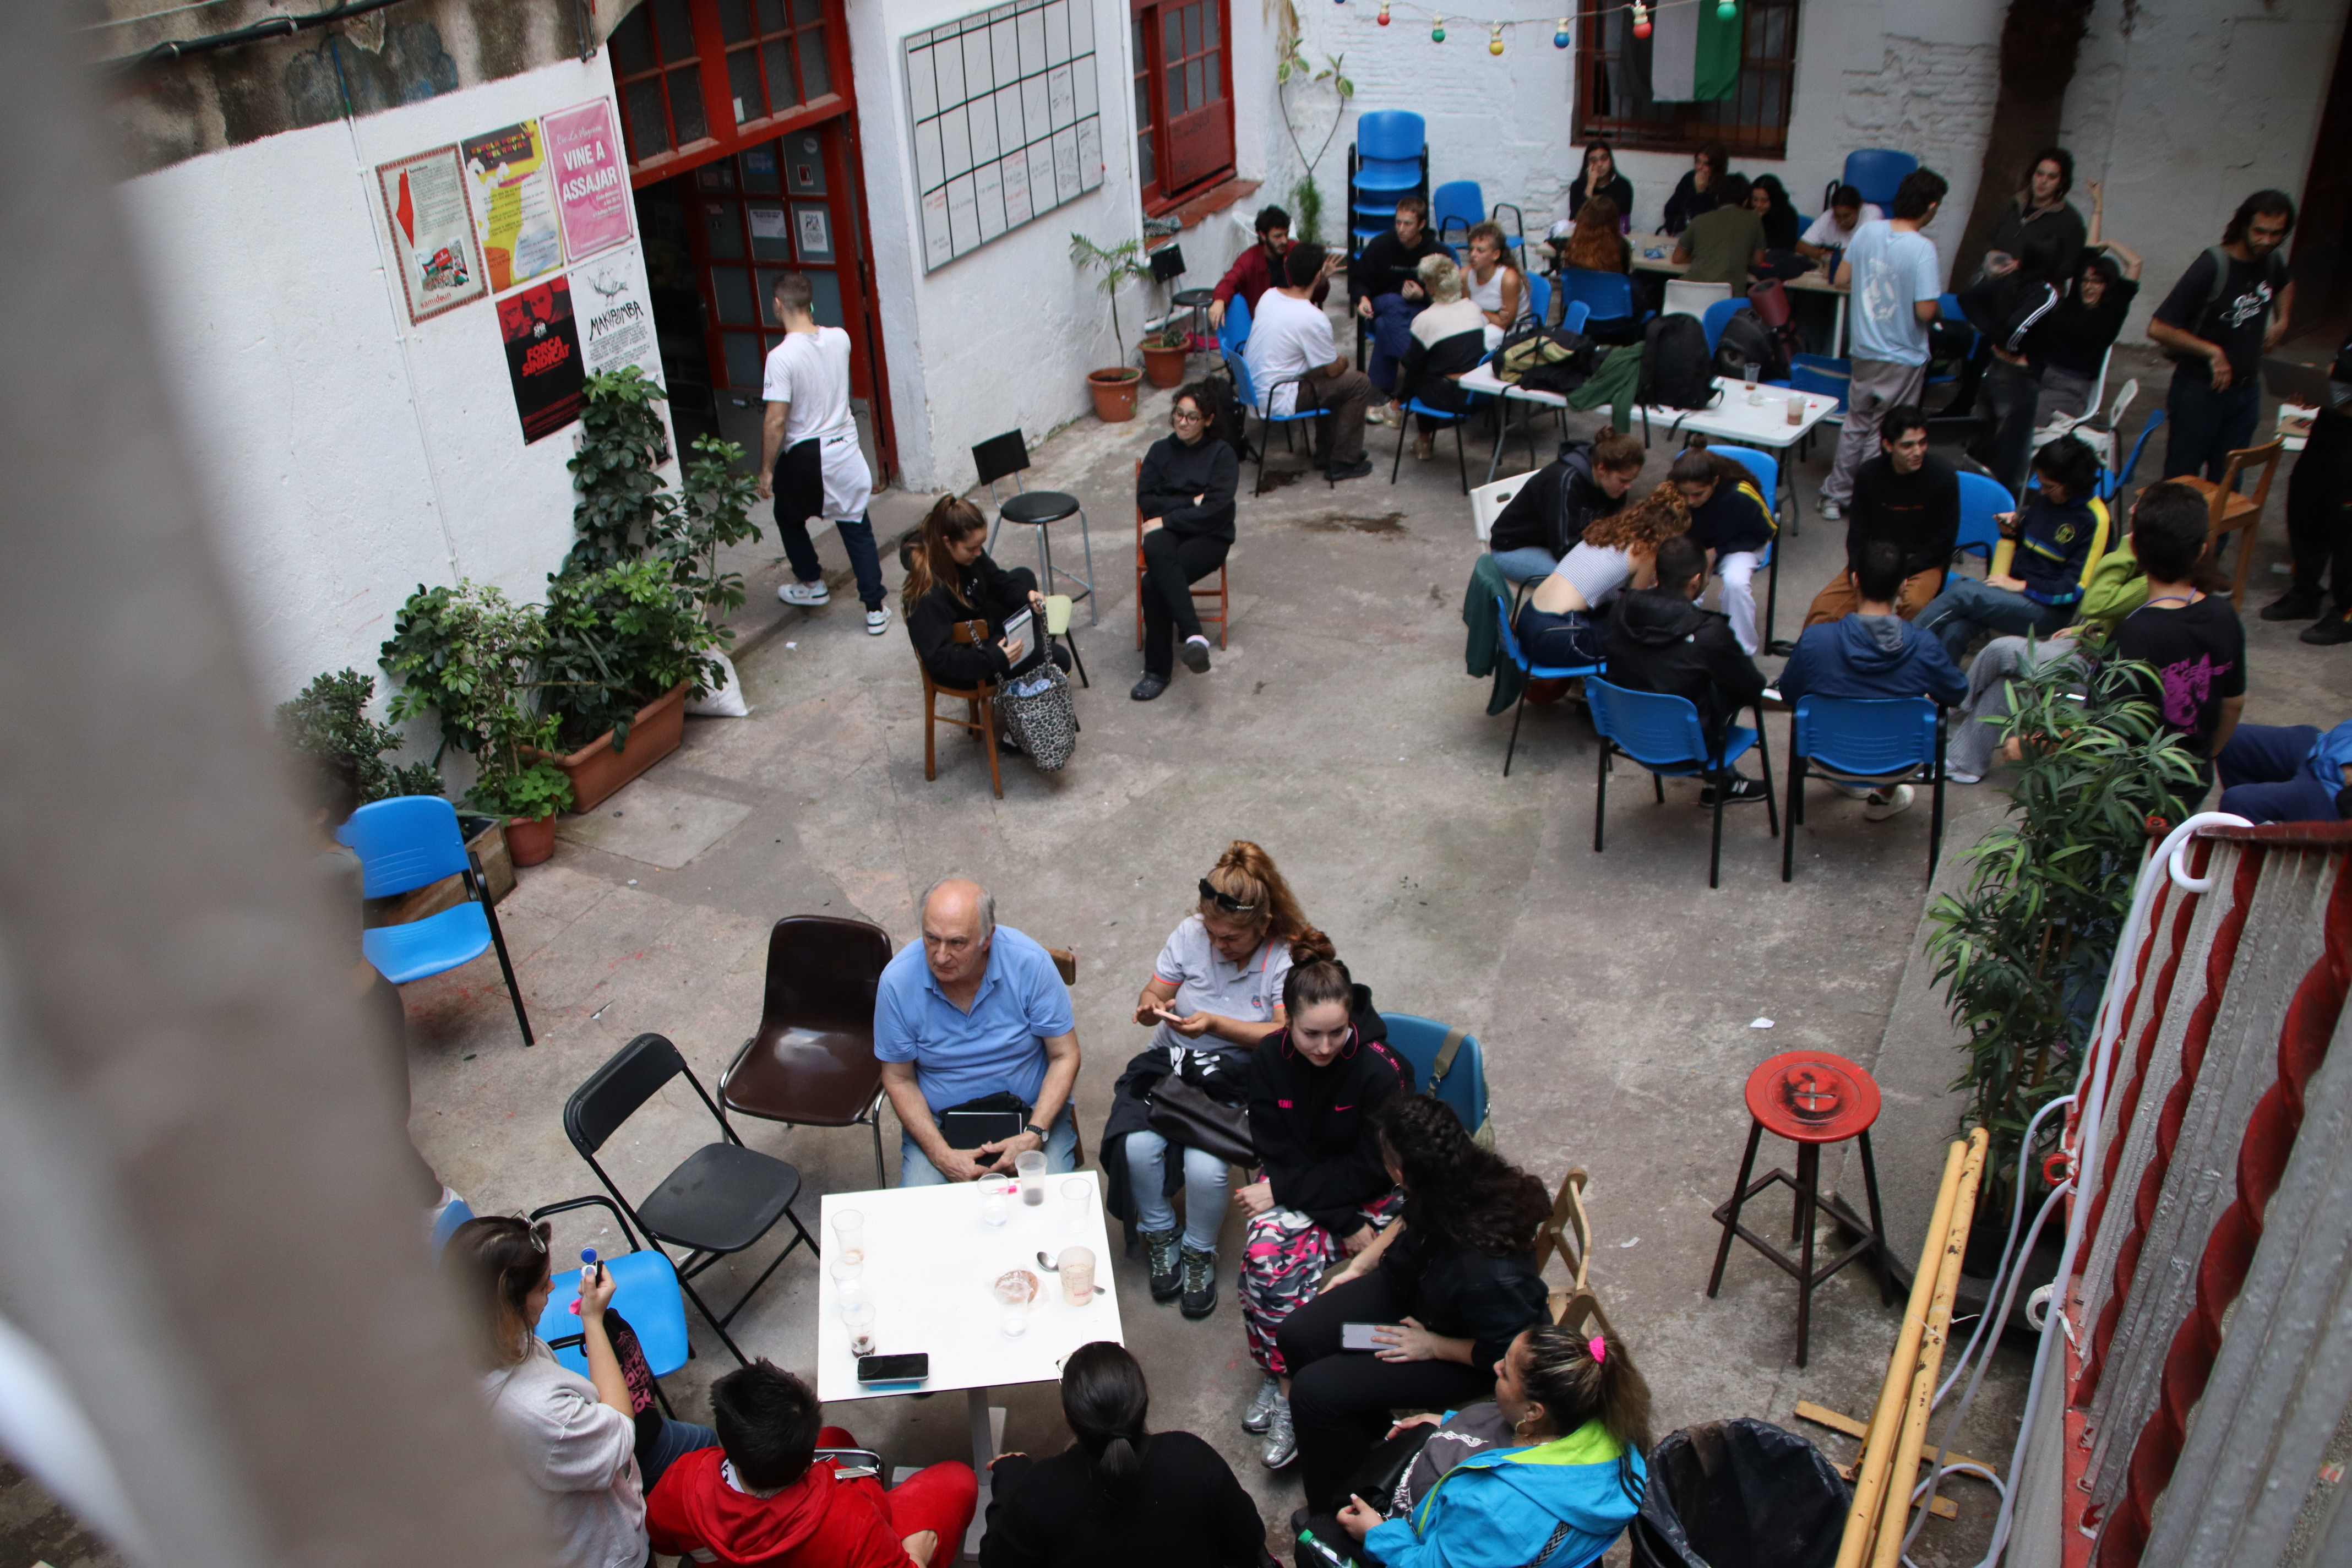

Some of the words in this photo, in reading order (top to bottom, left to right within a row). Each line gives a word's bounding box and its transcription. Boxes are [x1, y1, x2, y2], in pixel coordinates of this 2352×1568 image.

[471, 140, 500, 155] ESCOLA
[486, 149, 501, 159] DEL
[502, 141, 527, 154] RAVAL
[563, 143, 594, 172] VINE
[596, 140, 606, 161] A
[563, 165, 618, 203] ASSAJAR
[420, 292, 451, 309] samidoun
[521, 342, 570, 377] SINDICAT
